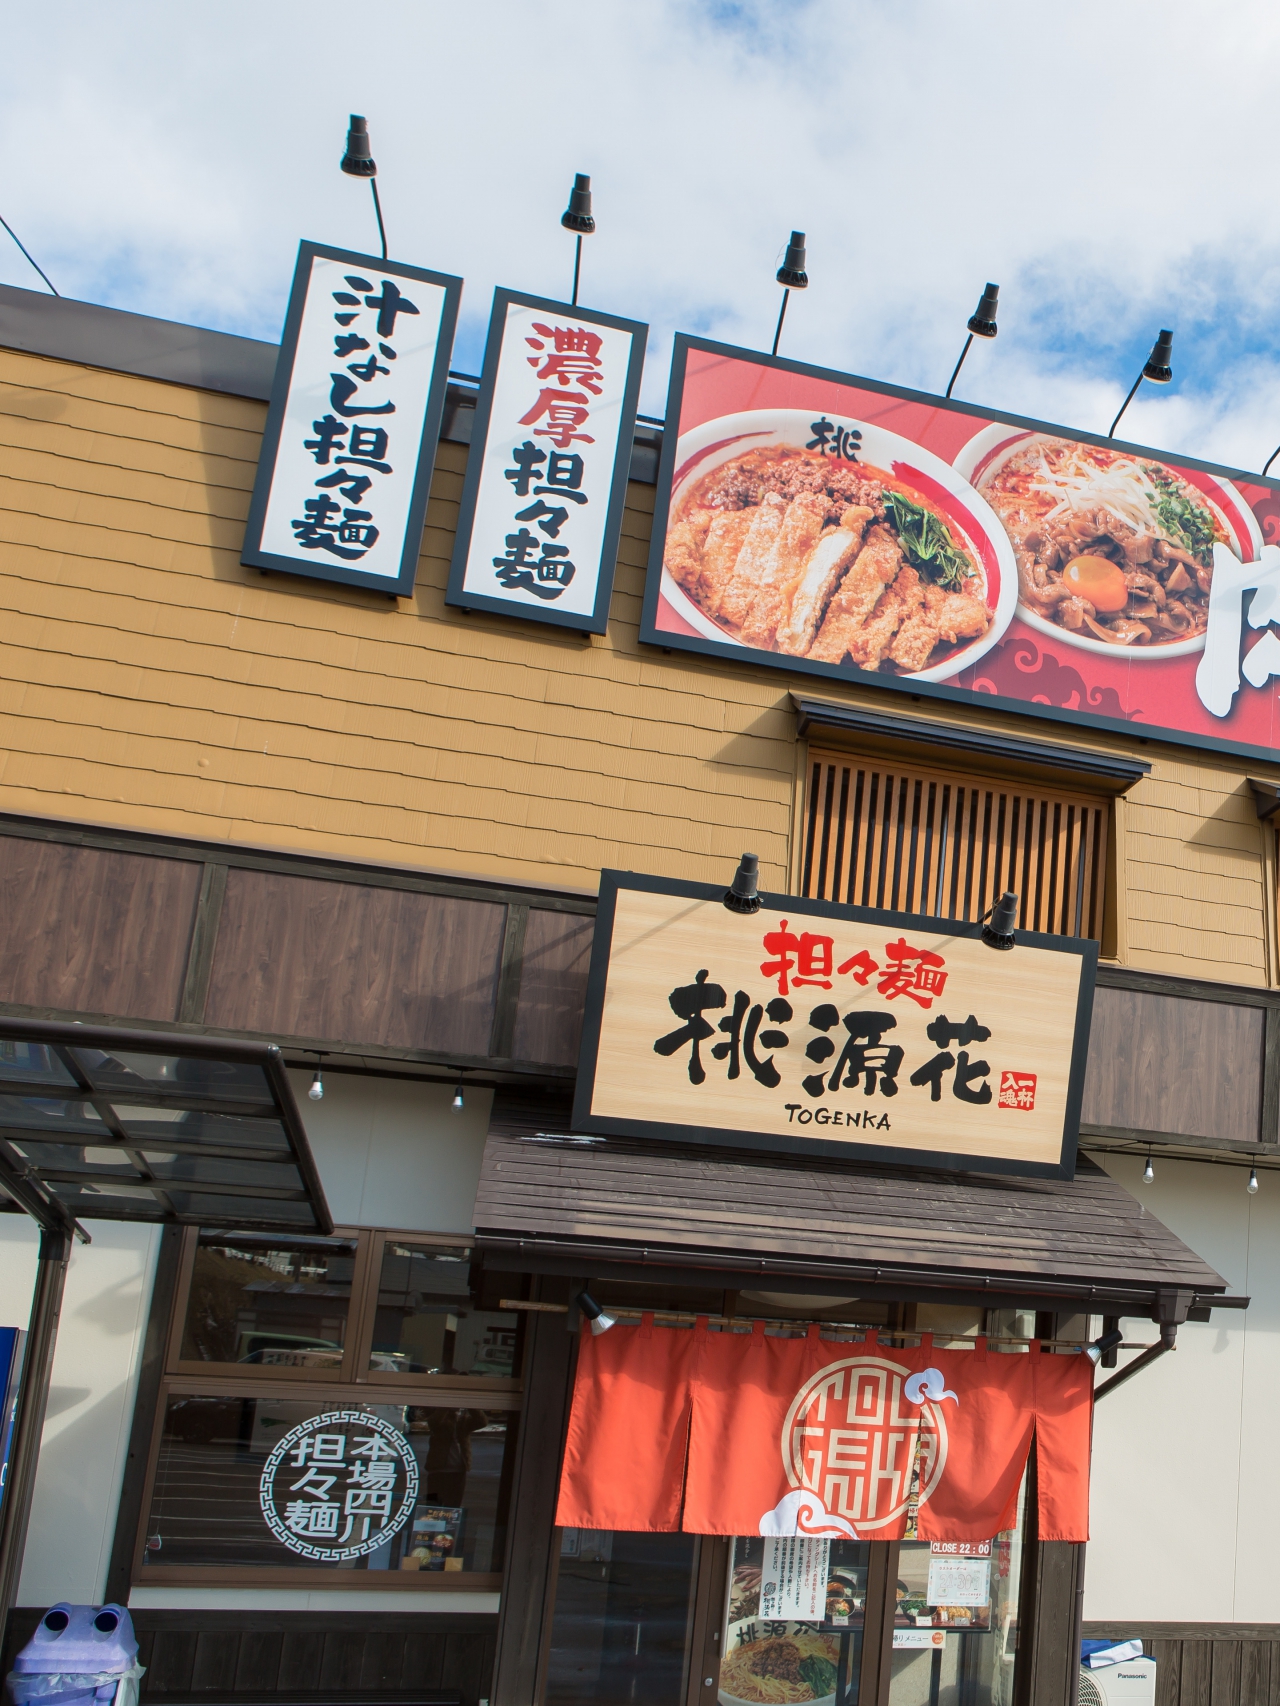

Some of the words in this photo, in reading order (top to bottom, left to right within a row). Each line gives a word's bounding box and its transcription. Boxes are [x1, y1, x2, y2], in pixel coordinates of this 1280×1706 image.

[291, 275, 419, 560] 汁なし担々麺
[493, 322, 604, 599] 濃厚担々麺
[805, 416, 862, 462] 桃
[760, 919, 949, 1009] 担々麺
[653, 968, 993, 1106] 桃源花
[784, 1103, 892, 1132] TOGENKA
[283, 1433, 343, 1539] 担々麺
[344, 1432, 398, 1543] 本場四川
[932, 1542, 957, 1553] CLOSE
